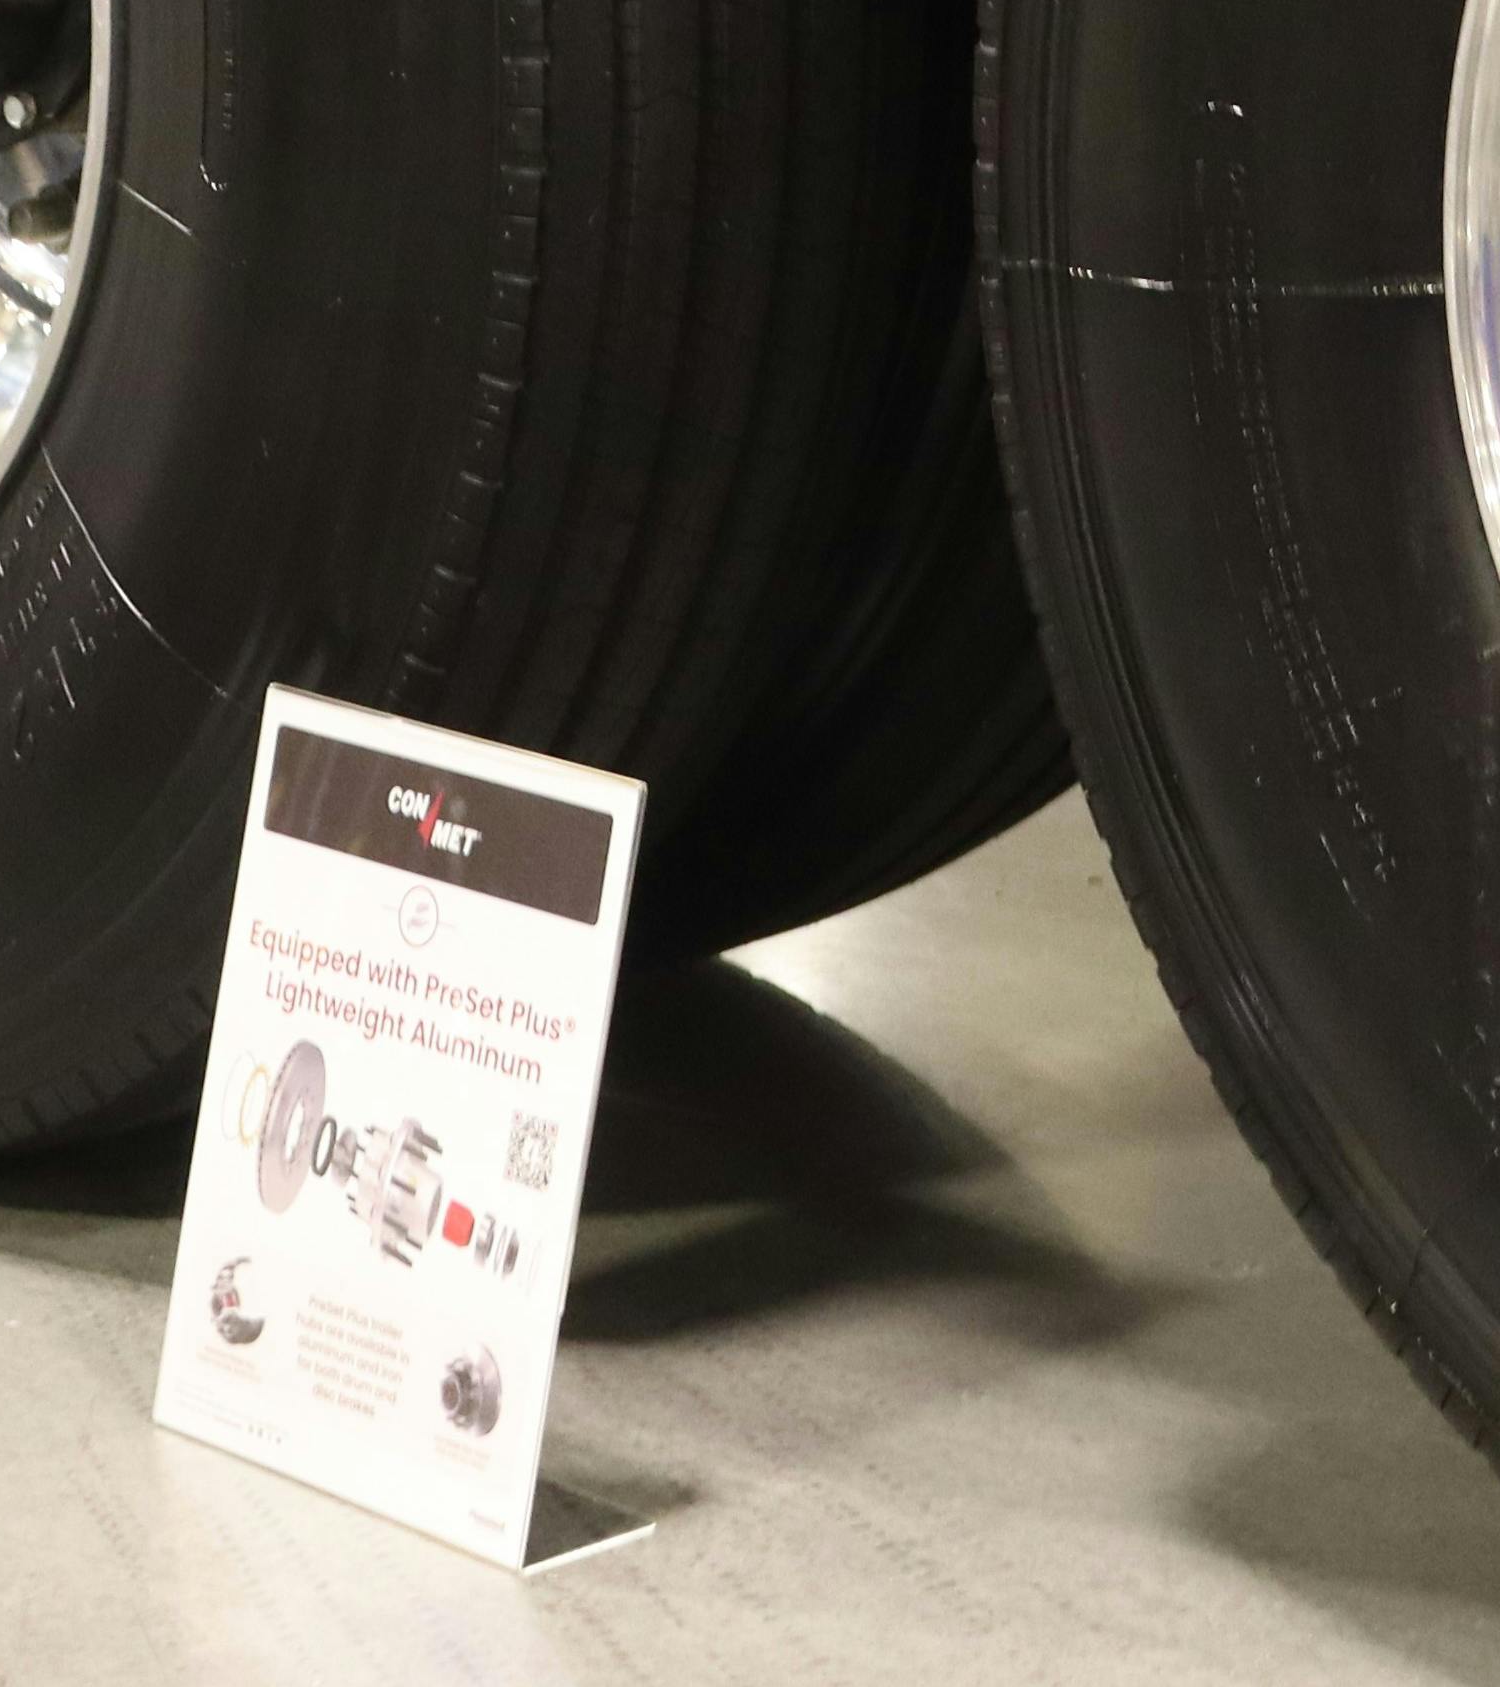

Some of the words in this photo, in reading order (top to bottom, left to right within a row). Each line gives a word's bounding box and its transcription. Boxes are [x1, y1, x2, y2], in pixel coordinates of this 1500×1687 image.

[387, 785, 431, 821] CON
[430, 818, 481, 857] MET
[249, 919, 362, 977] Equipped
[367, 957, 418, 997] with
[424, 973, 505, 1023] PreSet
[264, 971, 405, 1041] Lightweight
[409, 1018, 543, 1086] Aluminum
